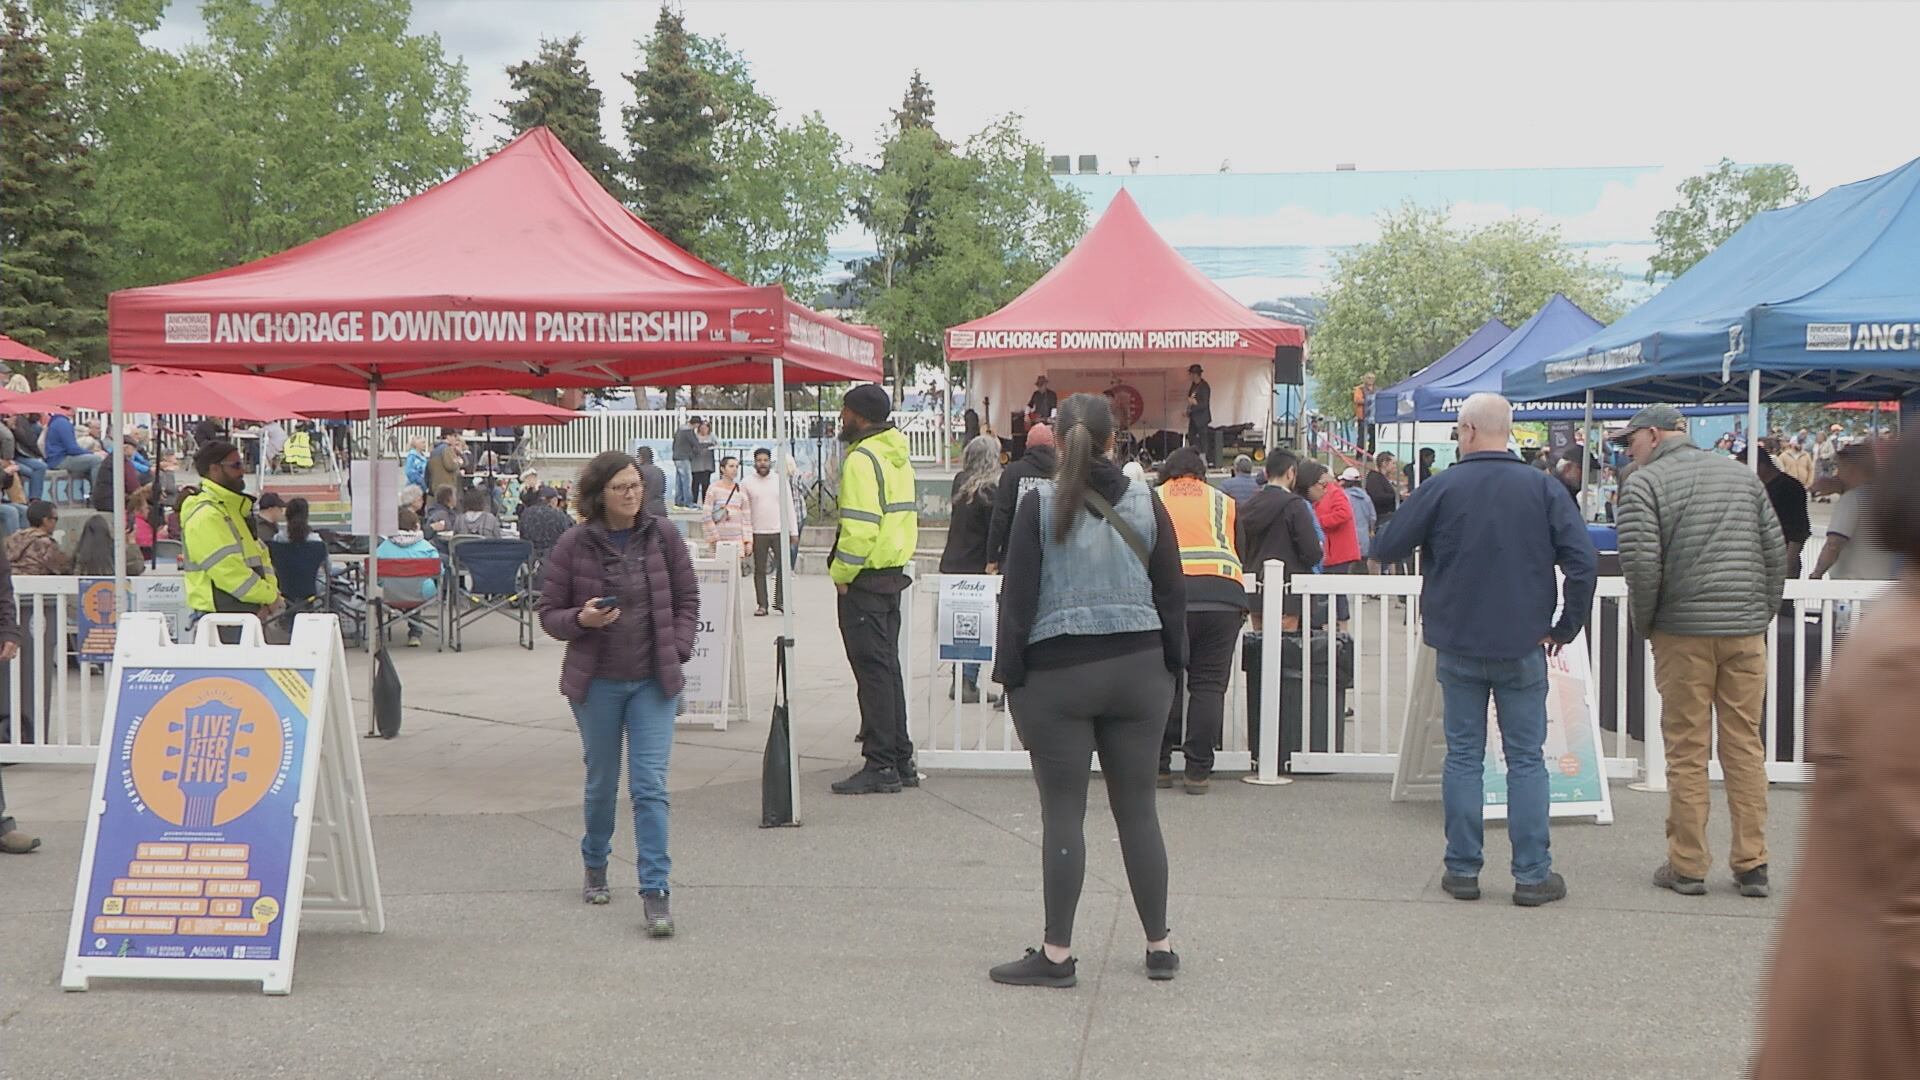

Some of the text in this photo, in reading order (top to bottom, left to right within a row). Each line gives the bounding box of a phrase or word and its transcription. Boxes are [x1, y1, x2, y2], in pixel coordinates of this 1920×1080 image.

[215, 312, 363, 343] ANCHORAGE
[371, 310, 526, 342] DOWNTOWN
[535, 311, 708, 342] PARTNERSHIP
[976, 331, 1057, 349] ANCHORAGE
[1060, 331, 1144, 349] DOWNTOWN
[1148, 331, 1240, 349] PARTNERSHIP
[950, 580, 986, 591] Alaska
[127, 669, 176, 683] Alaska
[191, 715, 232, 738] LIVE
[189, 737, 227, 759] AFTER
[184, 757, 226, 783] FIVE
